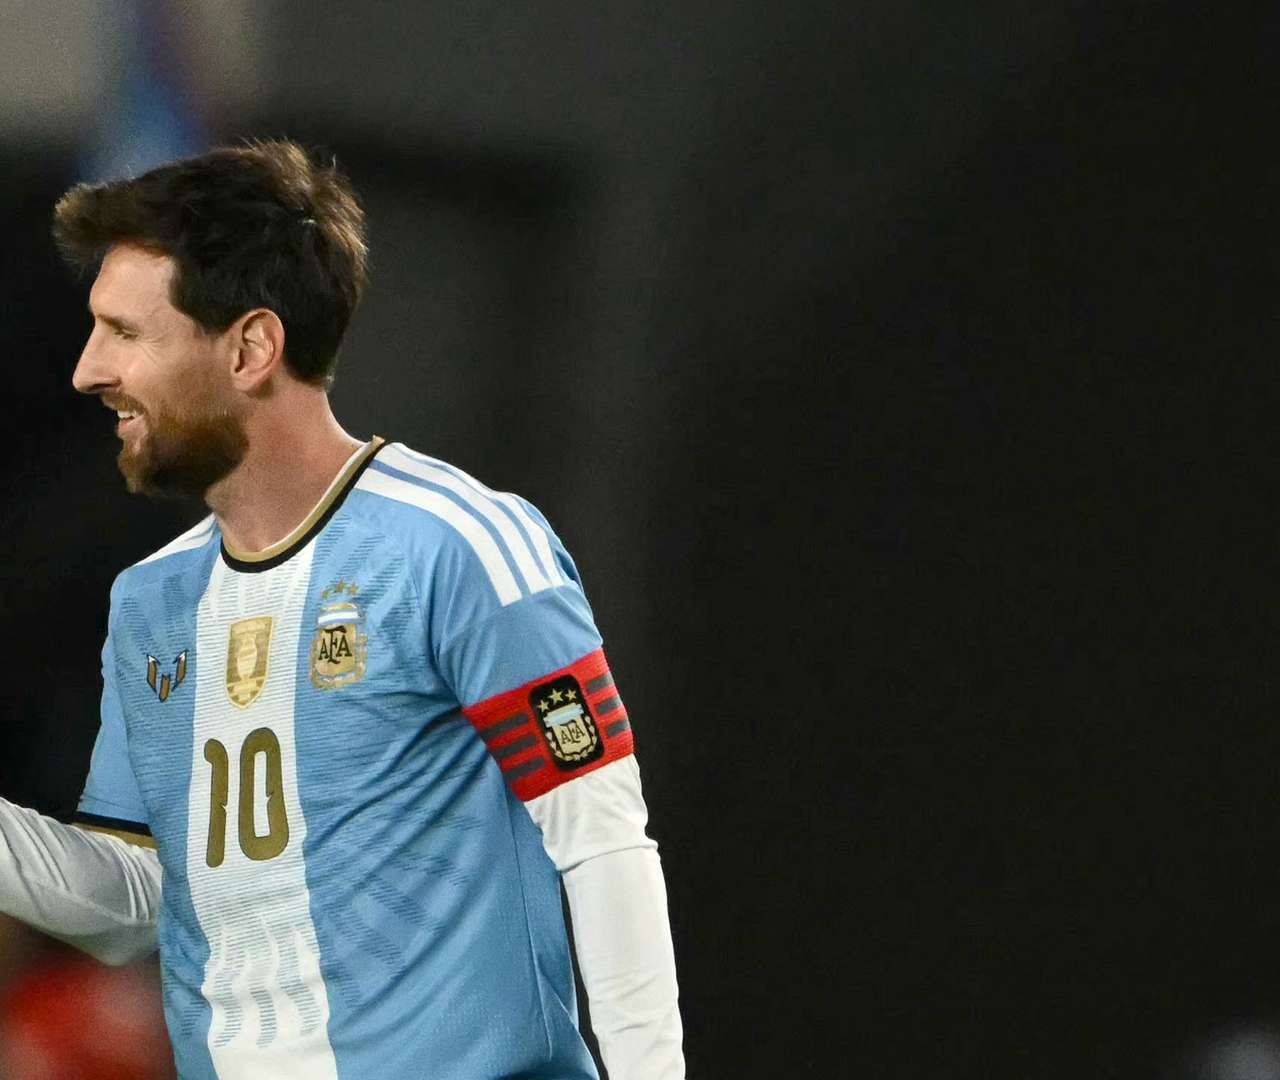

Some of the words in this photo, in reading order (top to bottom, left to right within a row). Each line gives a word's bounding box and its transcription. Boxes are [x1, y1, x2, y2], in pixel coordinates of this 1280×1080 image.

[318, 625, 352, 665] AFA
[559, 719, 585, 744] AFA
[203, 727, 290, 868] 10
